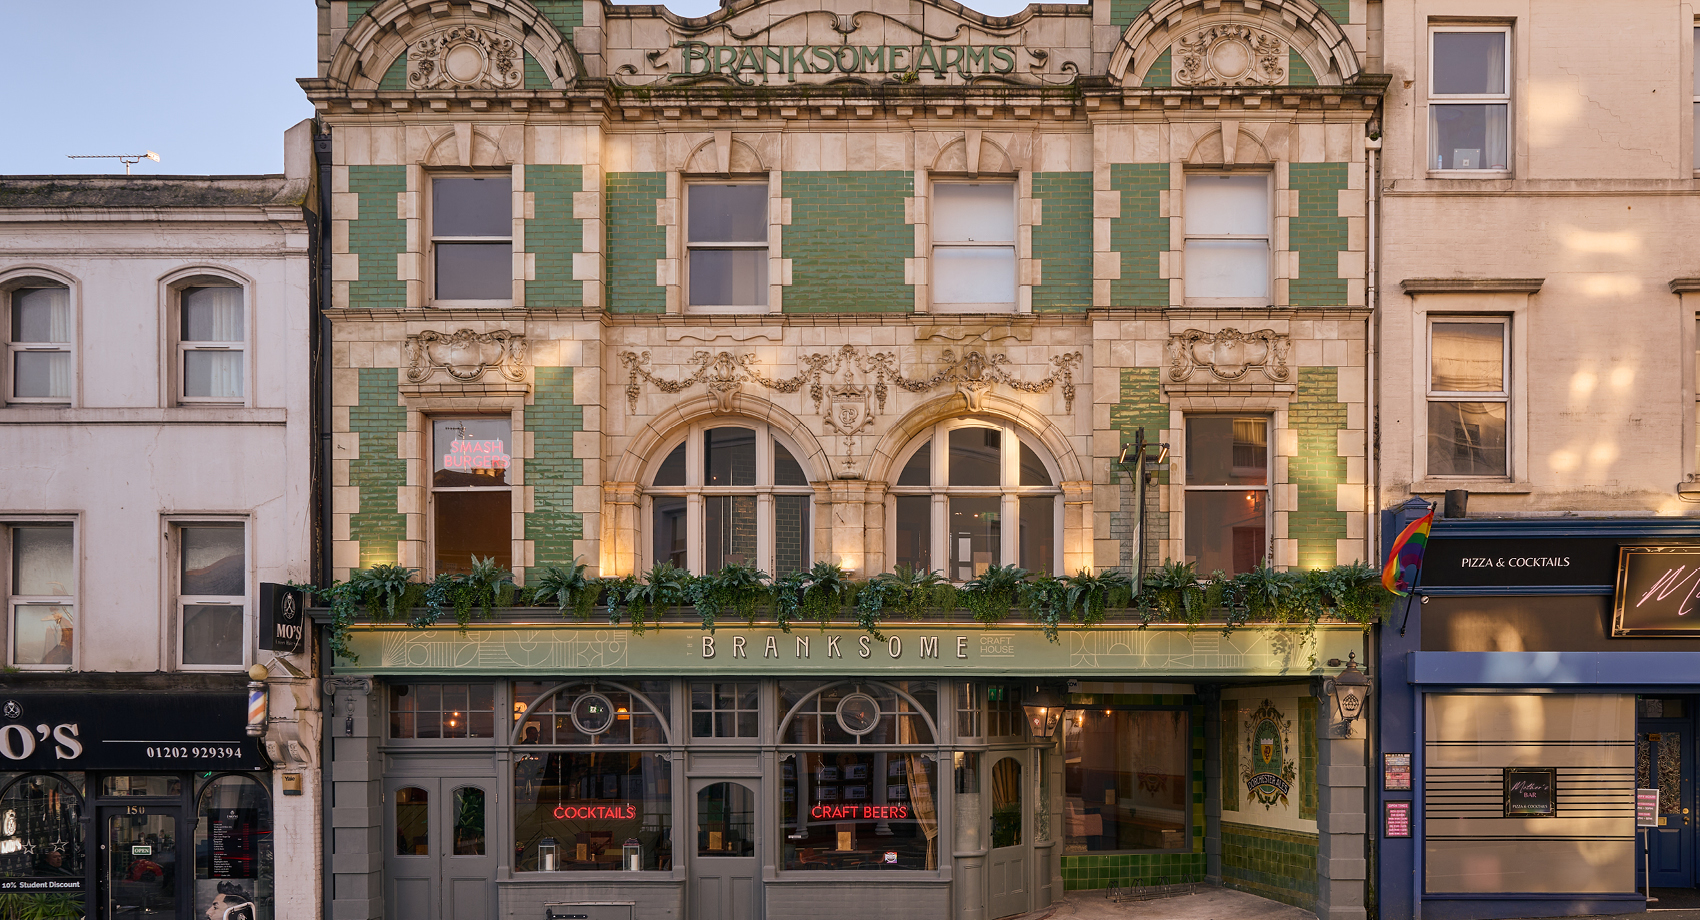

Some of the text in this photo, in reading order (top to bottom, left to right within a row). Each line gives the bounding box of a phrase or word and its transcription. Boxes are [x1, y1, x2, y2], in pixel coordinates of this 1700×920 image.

[667, 40, 1016, 85] BRANKSOME ARMS
[451, 441, 502, 453] SMASH
[444, 455, 509, 468] BURGERS
[1461, 556, 1570, 568] PIZZA & COCKTAILS
[276, 623, 302, 640] MO'S
[701, 635, 968, 660] BRANKSOME
[980, 637, 1011, 645] CRAFT
[980, 645, 1015, 653] HOUSE
[0, 724, 83, 760] O'S
[146, 746, 242, 758] 01202 929394
[1248, 774, 1289, 795] DORCHESTER ALES
[1511, 780, 1549, 793] Mother's
[126, 805, 145, 815] 150
[553, 806, 635, 819] COCKTAILS
[811, 805, 908, 819] CRAFT BEERS
[19, 881, 48, 889] Student
